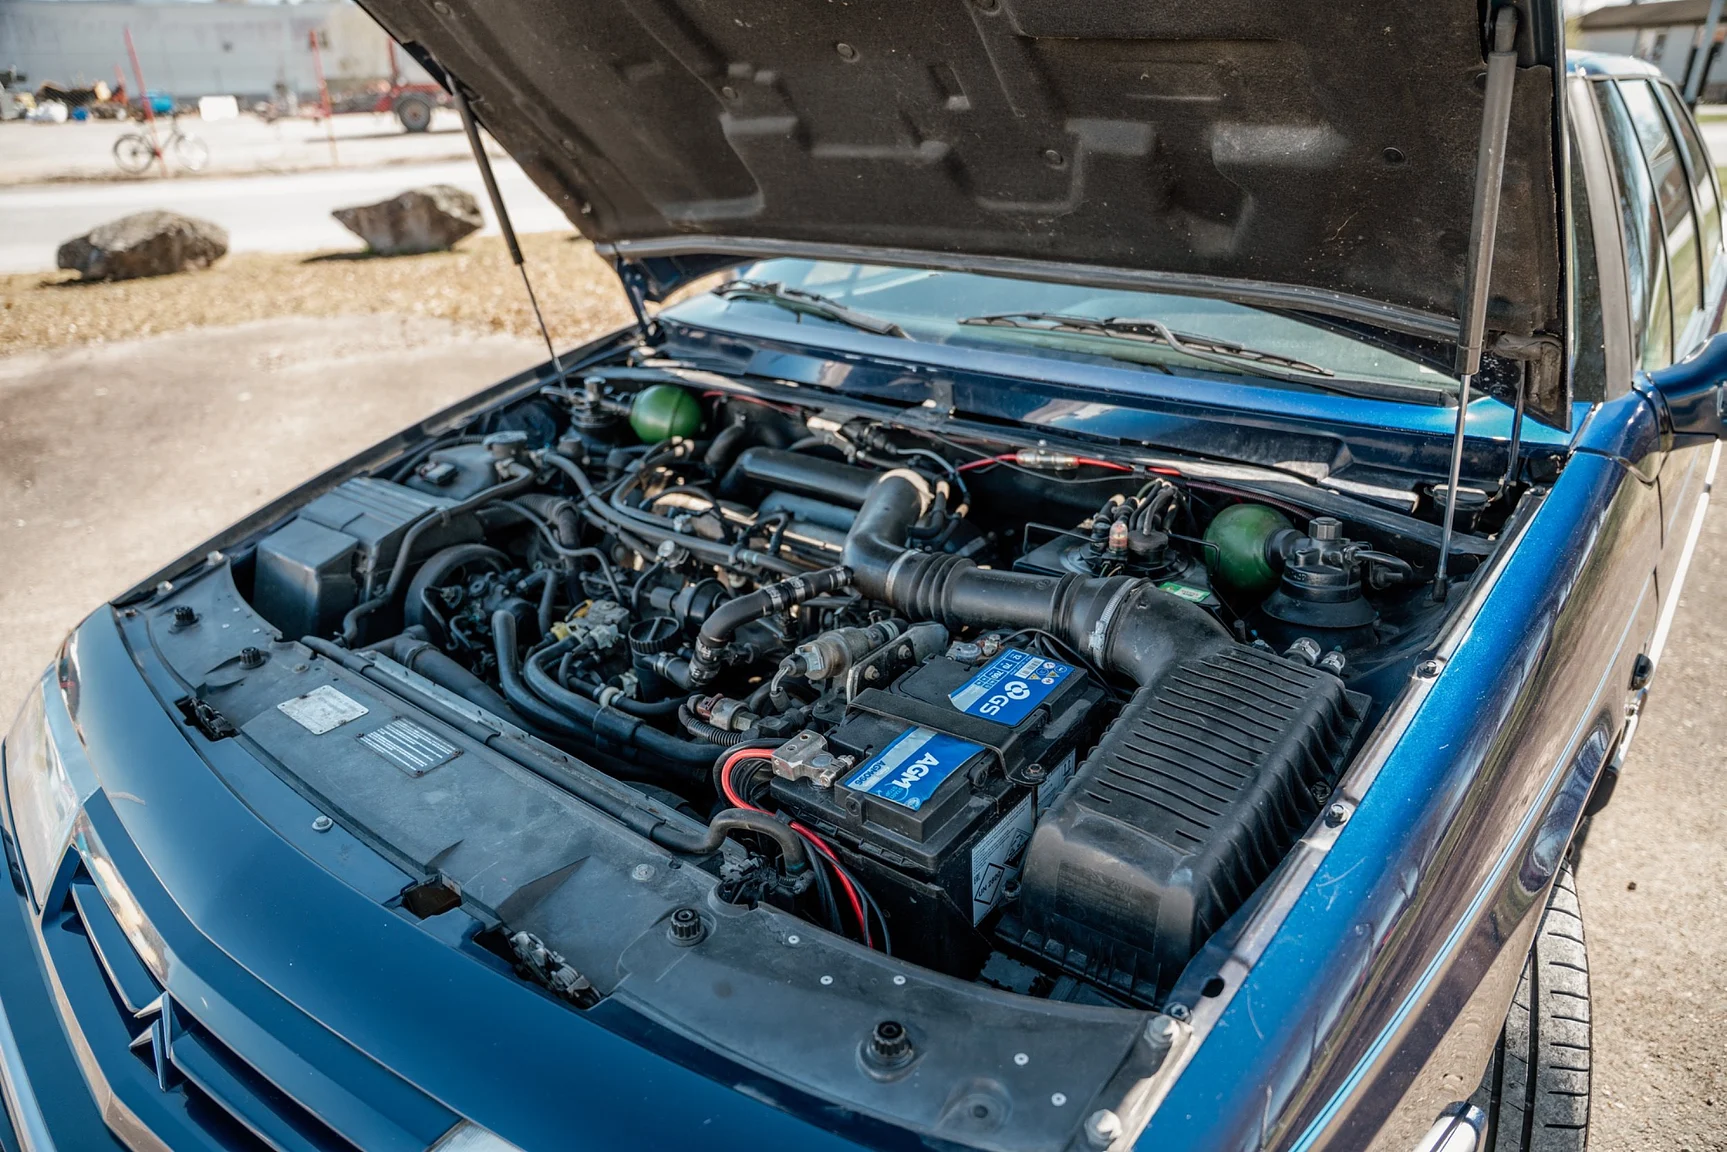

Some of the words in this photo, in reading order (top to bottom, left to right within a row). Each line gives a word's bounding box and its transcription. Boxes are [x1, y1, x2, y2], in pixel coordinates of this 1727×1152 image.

[979, 695, 1009, 716] GS
[855, 760, 886, 785] AGM096
[891, 752, 940, 789] AGM
